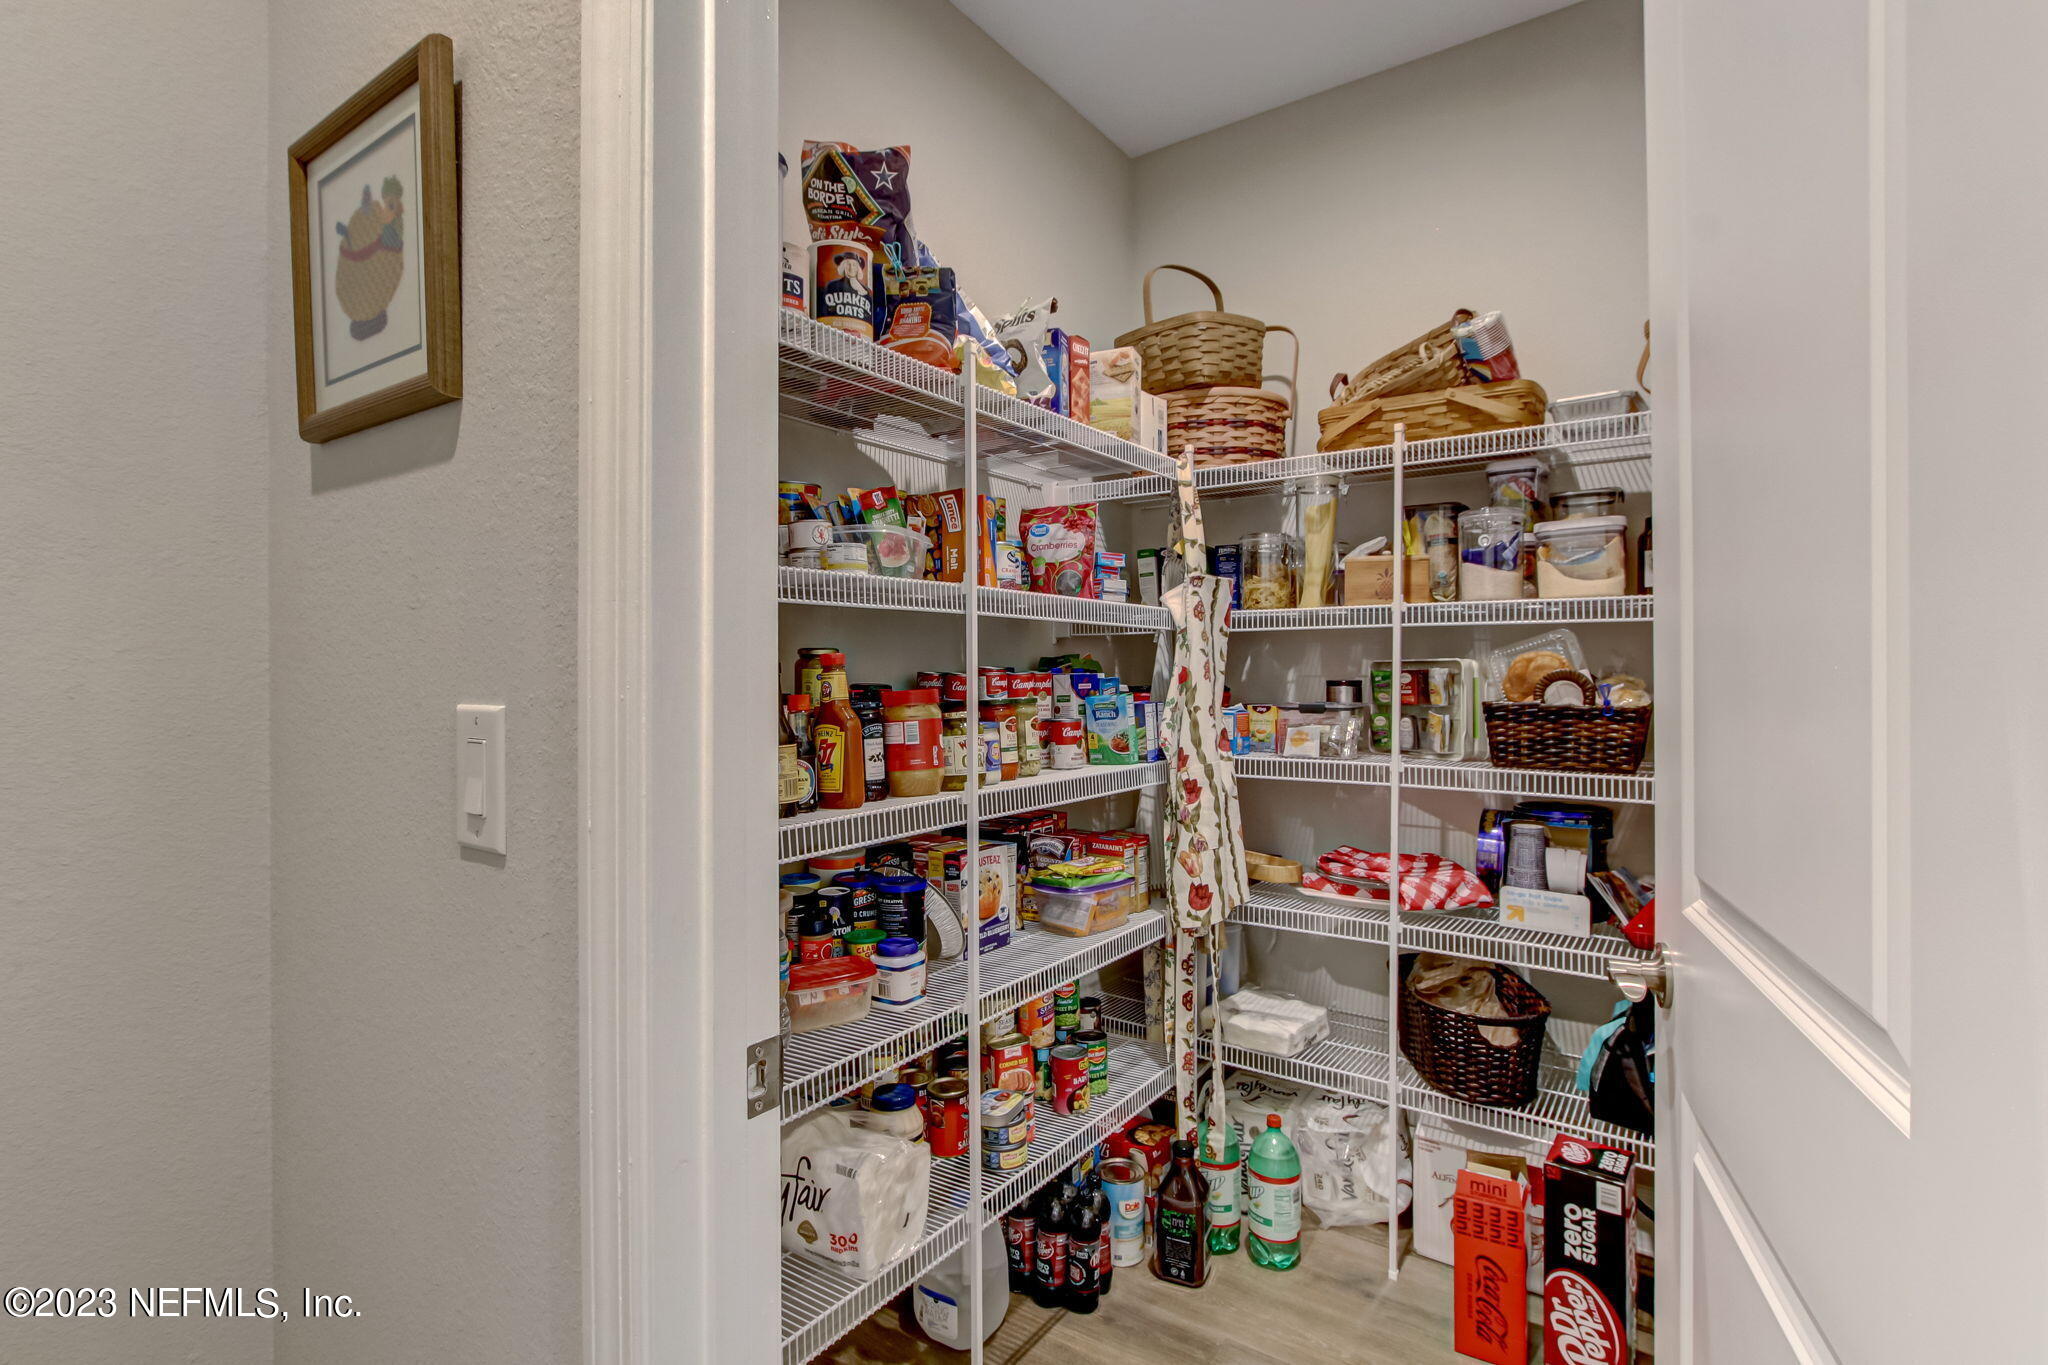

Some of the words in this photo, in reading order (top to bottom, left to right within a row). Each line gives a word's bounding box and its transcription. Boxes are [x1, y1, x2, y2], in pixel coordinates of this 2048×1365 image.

[810, 178, 823, 188] ON
[824, 181, 846, 193] THE
[808, 188, 856, 209] BORDER
[825, 292, 871, 315] QUAKER
[836, 305, 865, 319] OATS
[943, 497, 958, 529] Lance
[1031, 541, 1078, 552] Cranberries
[1096, 711, 1116, 719] Ranch
[818, 739, 837, 766] 57
[1092, 842, 1123, 852] ZATARAIN'S
[857, 944, 877, 954] CLAB
[1470, 1180, 1507, 1198] mini
[1125, 1202, 1140, 1211] Dole
[1455, 1199, 1471, 1236] mini
[1472, 1202, 1488, 1241] mini
[1489, 1206, 1505, 1246] mini
[1506, 1210, 1523, 1250] mini
[1563, 1203, 1582, 1261] zero
[829, 1232, 858, 1247] 300
[1581, 1207, 1598, 1266] SUGAR
[1550, 1296, 1583, 1340] Dr
